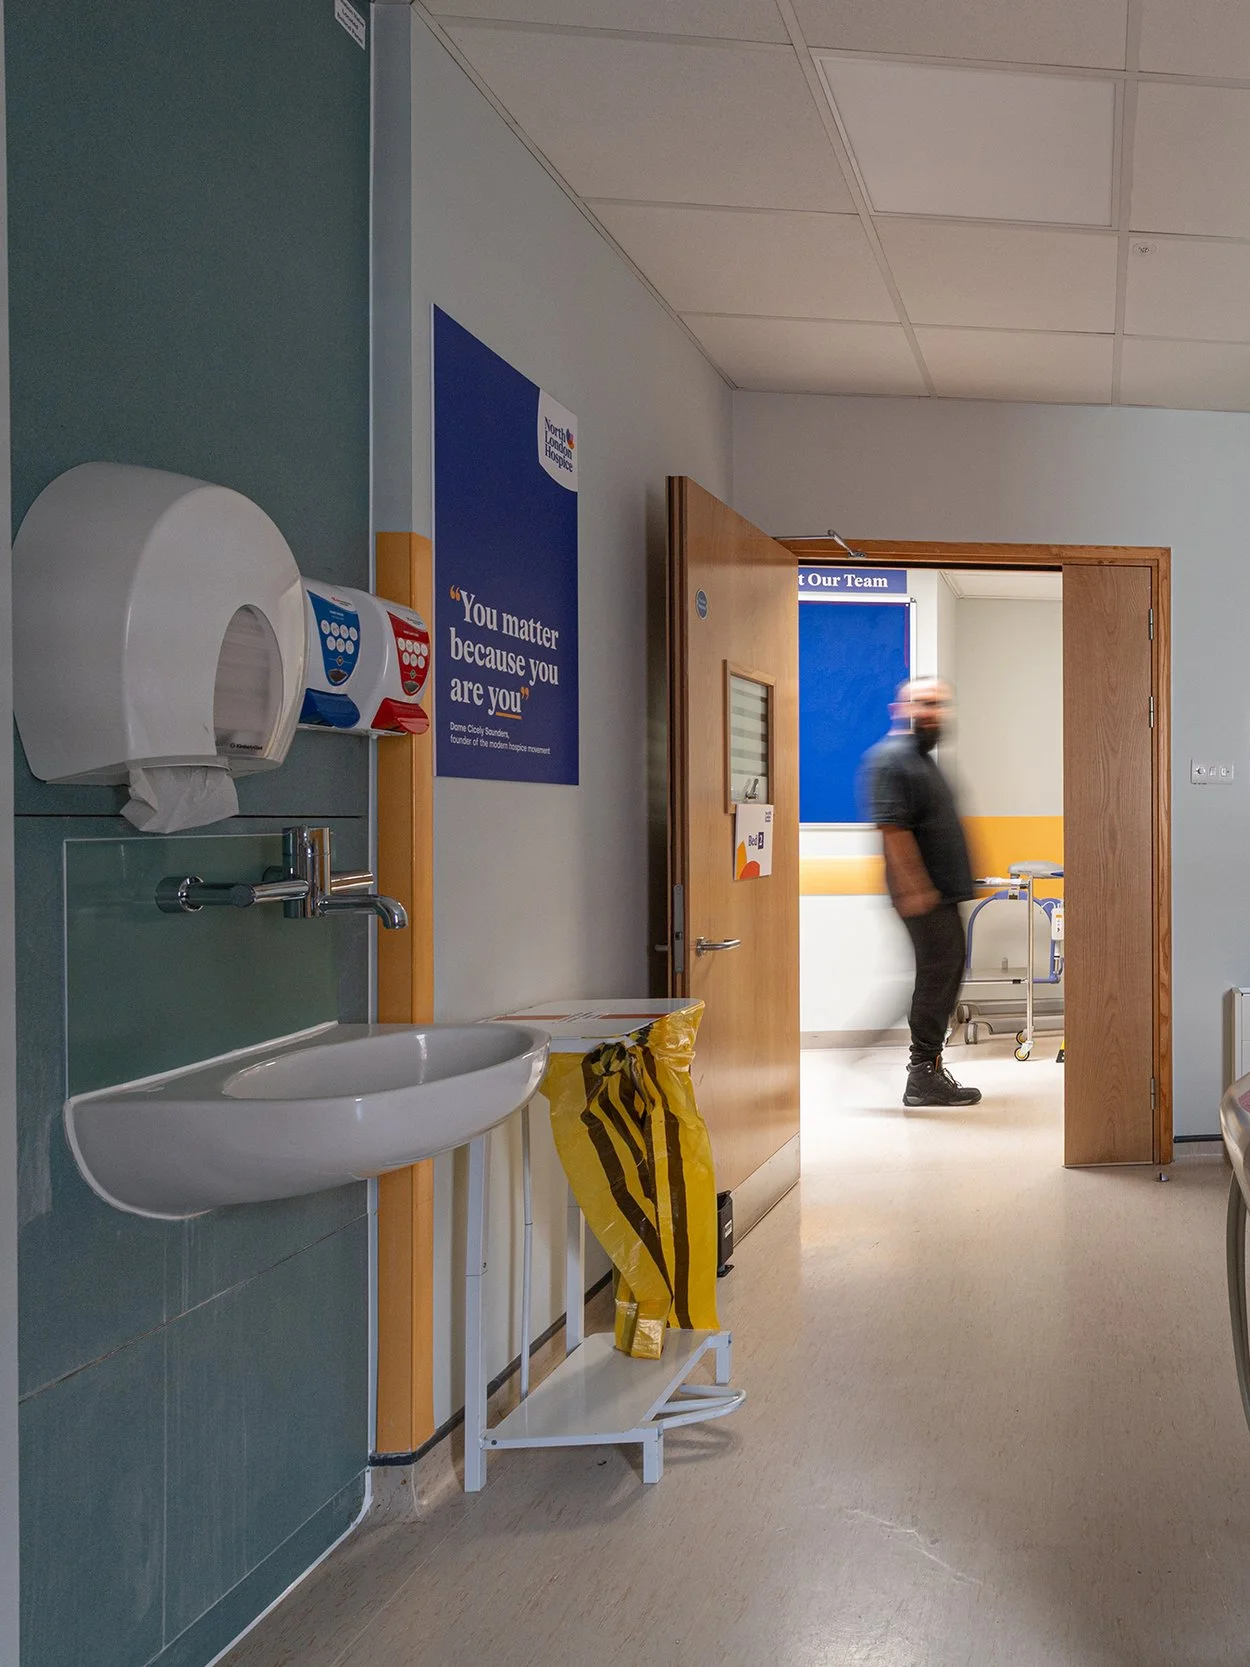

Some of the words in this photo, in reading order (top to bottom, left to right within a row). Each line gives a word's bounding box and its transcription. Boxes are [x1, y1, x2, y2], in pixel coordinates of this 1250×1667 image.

[545, 416, 566, 442] North
[545, 431, 573, 459] London
[545, 444, 573, 472] Hospice
[807, 573, 841, 587] Our
[843, 574, 888, 588] Team
[502, 612, 559, 650] matter
[450, 627, 525, 677] because
[529, 657, 559, 686] you
[451, 678, 483, 706] are
[450, 721, 467, 732] Dame
[467, 724, 484, 736] Cicely
[485, 727, 510, 739] Saunders,
[450, 734, 472, 746] founder
[473, 737, 479, 747] of
[480, 738, 489, 748] the
[489, 740, 508, 751] modern
[508, 742, 527, 753] hospice
[748, 834, 758, 846] Bed
